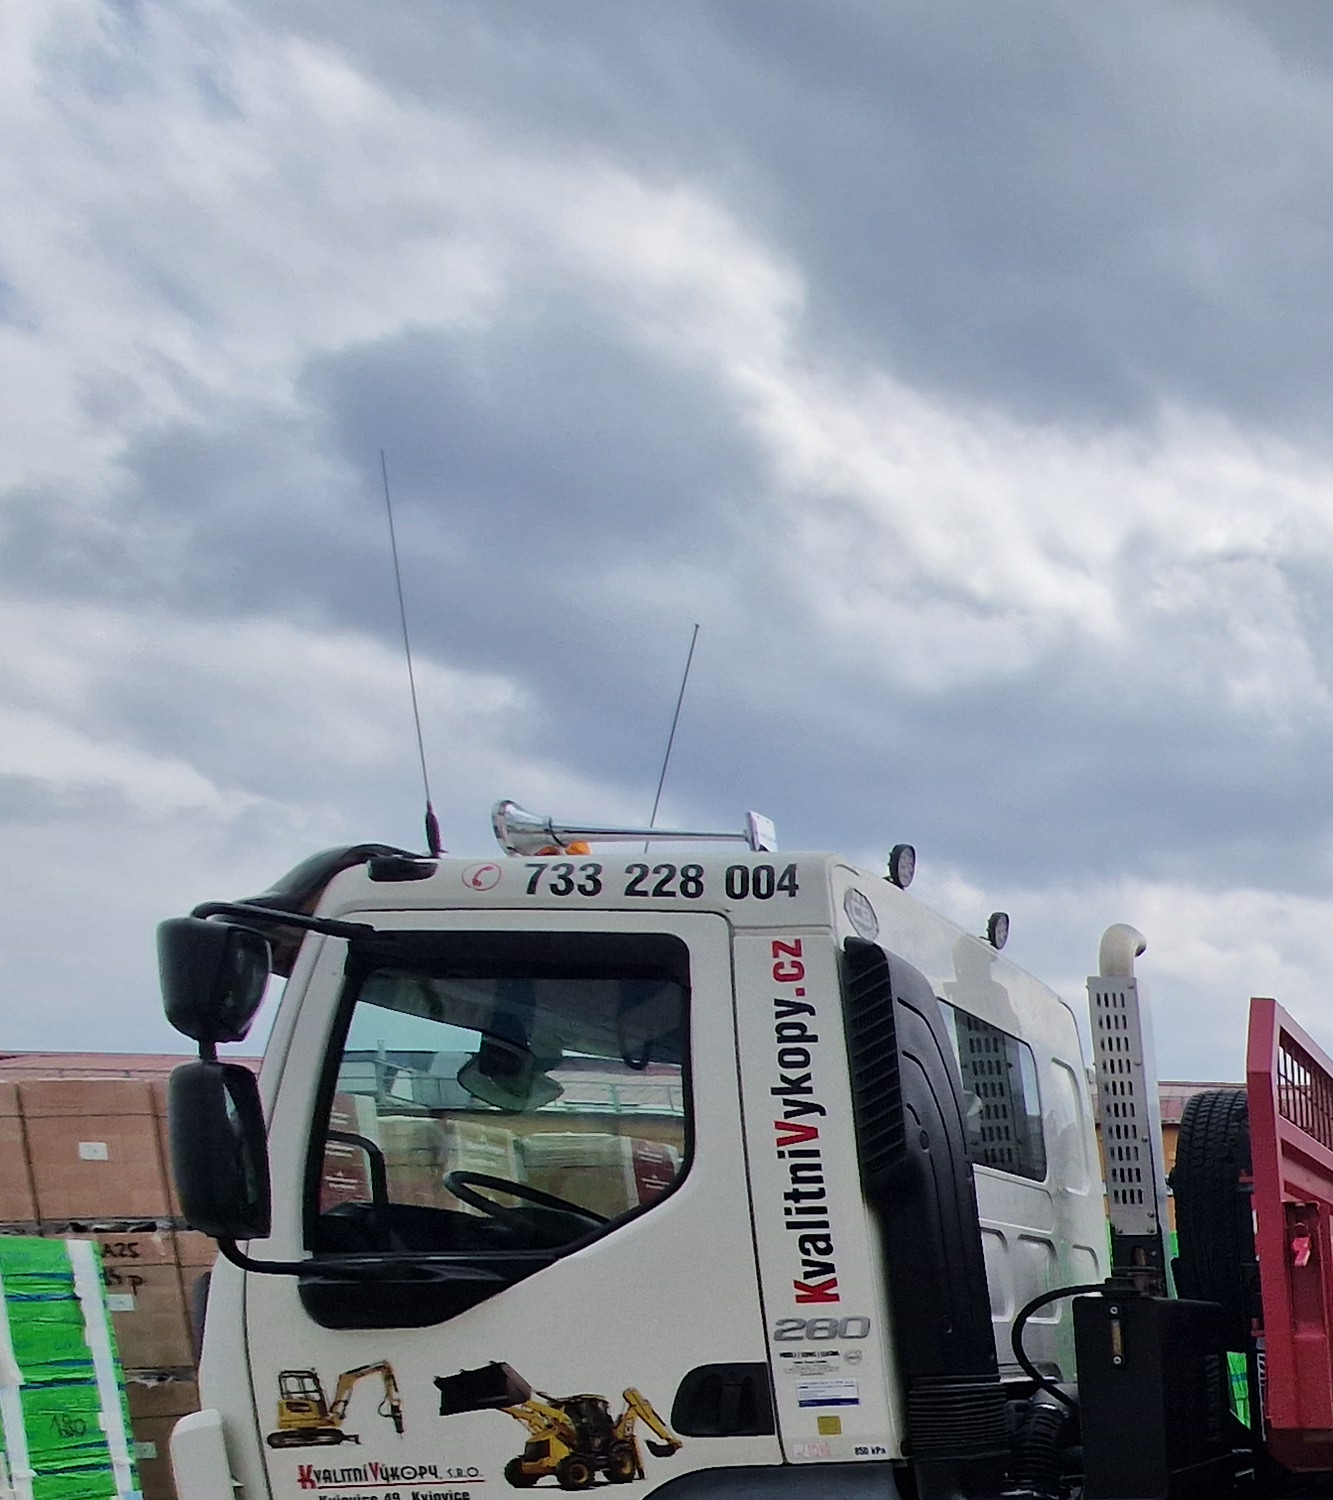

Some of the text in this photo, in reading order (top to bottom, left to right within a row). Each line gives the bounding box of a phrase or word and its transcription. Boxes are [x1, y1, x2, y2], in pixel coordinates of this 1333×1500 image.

[525, 863, 799, 899] 733 228 004
[770, 939, 840, 1304] KvalitniVykopy.cz
[774, 1316, 871, 1341] 280
